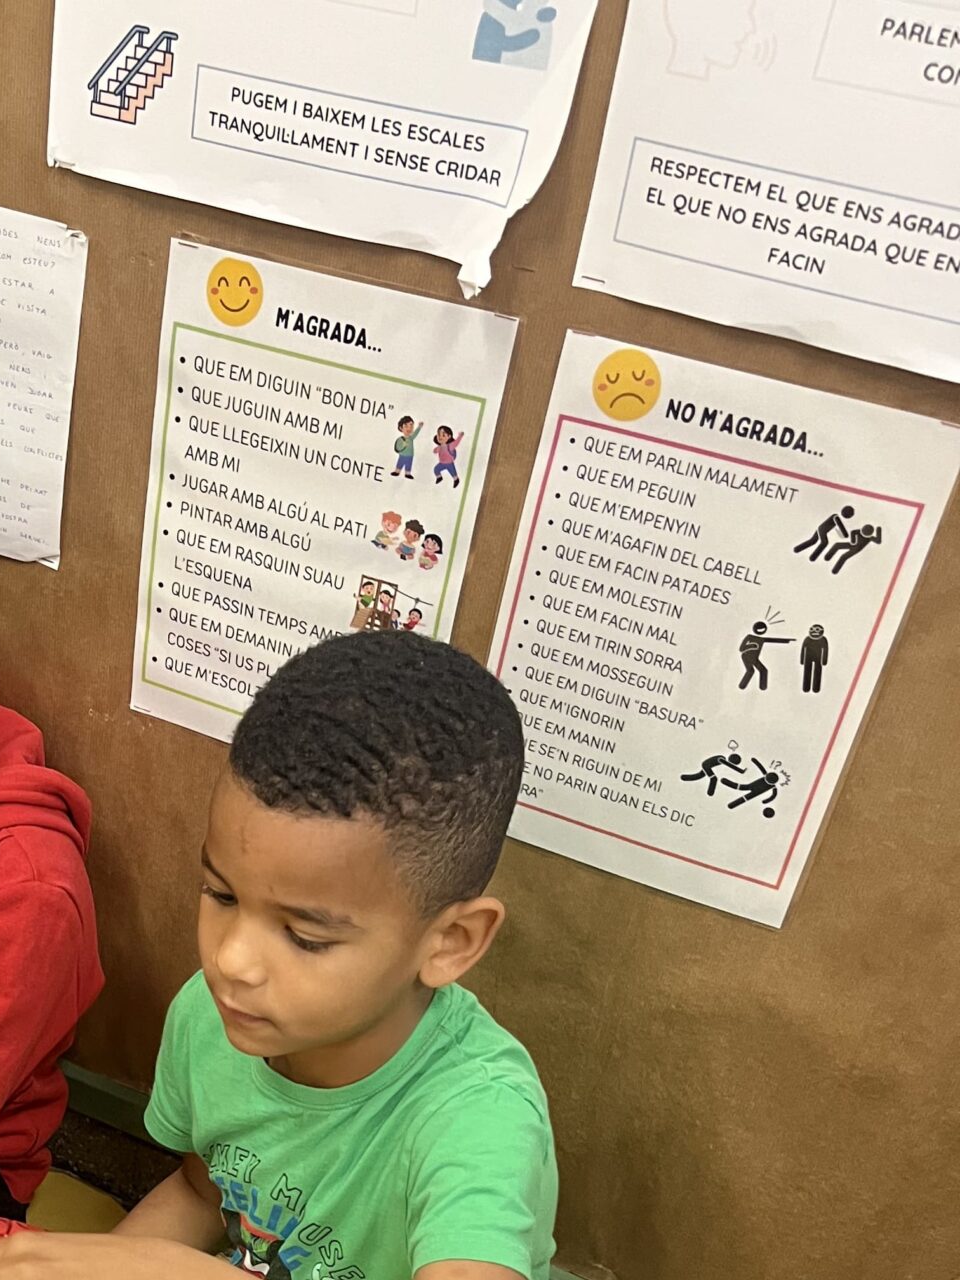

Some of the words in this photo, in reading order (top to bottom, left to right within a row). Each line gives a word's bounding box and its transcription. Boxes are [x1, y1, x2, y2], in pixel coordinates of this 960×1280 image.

[231, 86, 288, 114] PUGEM
[292, 100, 298, 116] I
[302, 102, 366, 130] BAIXEM
[371, 116, 402, 137] LES
[407, 123, 486, 152] ESCALES
[364, 144, 369, 161] I
[373, 147, 430, 173] SENSE
[435, 159, 501, 187] CRIDAR
[650, 156, 762, 197] RESPECTEM
[766, 183, 788, 204] EL
[795, 190, 839, 214] QUE
[843, 200, 884, 224] ENS
[646, 186, 666, 207] EL
[673, 194, 713, 218] QUE
[717, 203, 747, 225] NO
[752, 212, 791, 235] ENS
[794, 223, 877, 256] AGRADA
[885, 243, 930, 267] QUE
[767, 247, 826, 275] FACIN
[194, 355, 226, 378] QUE
[229, 364, 252, 385] EM
[256, 371, 312, 400] DIGUIN
[191, 385, 222, 408] QUE
[224, 395, 281, 424] JUGUIN
[283, 410, 320, 434] AMB
[323, 420, 343, 440] MI
[665, 398, 696, 423] NO
[184, 444, 219, 467] AMB
[221, 454, 240, 473] MI
[189, 415, 220, 438] QUE
[223, 424, 300, 460] LLEGEIXIN
[304, 447, 327, 467] UN
[330, 454, 385, 483] CONTE
[584, 436, 617, 458] QUE
[618, 444, 643, 464] EM
[645, 452, 703, 479] PARLIN
[704, 467, 799, 503] MALAMENT
[181, 473, 228, 500] JUGAR
[230, 487, 265, 510] AMB
[267, 498, 308, 522] ALGÚ
[310, 510, 330, 529] AL
[333, 516, 368, 539] PATI
[576, 464, 609, 485] QUE
[610, 472, 634, 492] EM
[637, 480, 697, 508] PEGUIN
[180, 501, 233, 529] PINTAR
[235, 517, 268, 539] AMB
[270, 528, 312, 552] ALGÚ
[568, 491, 601, 513] QUE
[601, 500, 701, 539] M'EMPENYIN
[174, 555, 253, 592] L'ESQUENA
[176, 528, 207, 550] QUE
[209, 538, 231, 558] EM
[235, 545, 300, 578] RASQUIN
[302, 565, 345, 590] SUAU
[555, 544, 587, 565] QUE
[588, 553, 611, 572] EM
[614, 561, 659, 585] FACIN
[661, 574, 732, 605] PATADES
[561, 518, 594, 539] QUE
[594, 527, 668, 559] M'AGAFIN
[670, 547, 699, 569] DEL
[703, 557, 762, 586] CABELL
[171, 581, 201, 603] QUE
[203, 591, 254, 619] PASSIN
[258, 607, 308, 635] TEMPS
[542, 594, 573, 615] QUE
[575, 604, 597, 622] EM
[600, 611, 644, 635] FACIN
[645, 625, 677, 646] MAL
[549, 569, 580, 590] QUE
[581, 578, 604, 597] EM
[606, 586, 683, 620] MOLESTIN
[167, 631, 211, 657] COSES
[235, 653, 254, 672] US
[169, 607, 198, 628] QUE
[201, 617, 221, 636] EM
[225, 625, 293, 657] DEMANIN
[536, 619, 567, 639] QUE
[568, 628, 590, 646] EM
[594, 635, 632, 658] TIRIN
[633, 648, 683, 674] SORRA
[164, 656, 194, 677] QUE
[525, 666, 555, 686] QUE
[556, 675, 578, 693] EM
[580, 683, 631, 710] DIGUIN
[530, 642, 561, 663] QUE
[562, 652, 584, 670] EM
[586, 660, 674, 697] MOSSEGUIN
[519, 689, 549, 709] QUE
[549, 698, 625, 732] M'IGNORIN
[544, 721, 566, 738] EM
[567, 729, 616, 754] MANIN
[533, 764, 553, 781] NO
[556, 772, 598, 795] PARIN
[600, 786, 639, 809] QUAN
[642, 800, 669, 818] ELS
[670, 810, 695, 827] DIC
[572, 754, 620, 779] RIGUIN
[622, 770, 643, 787] DE
[643, 777, 662, 793] MI
